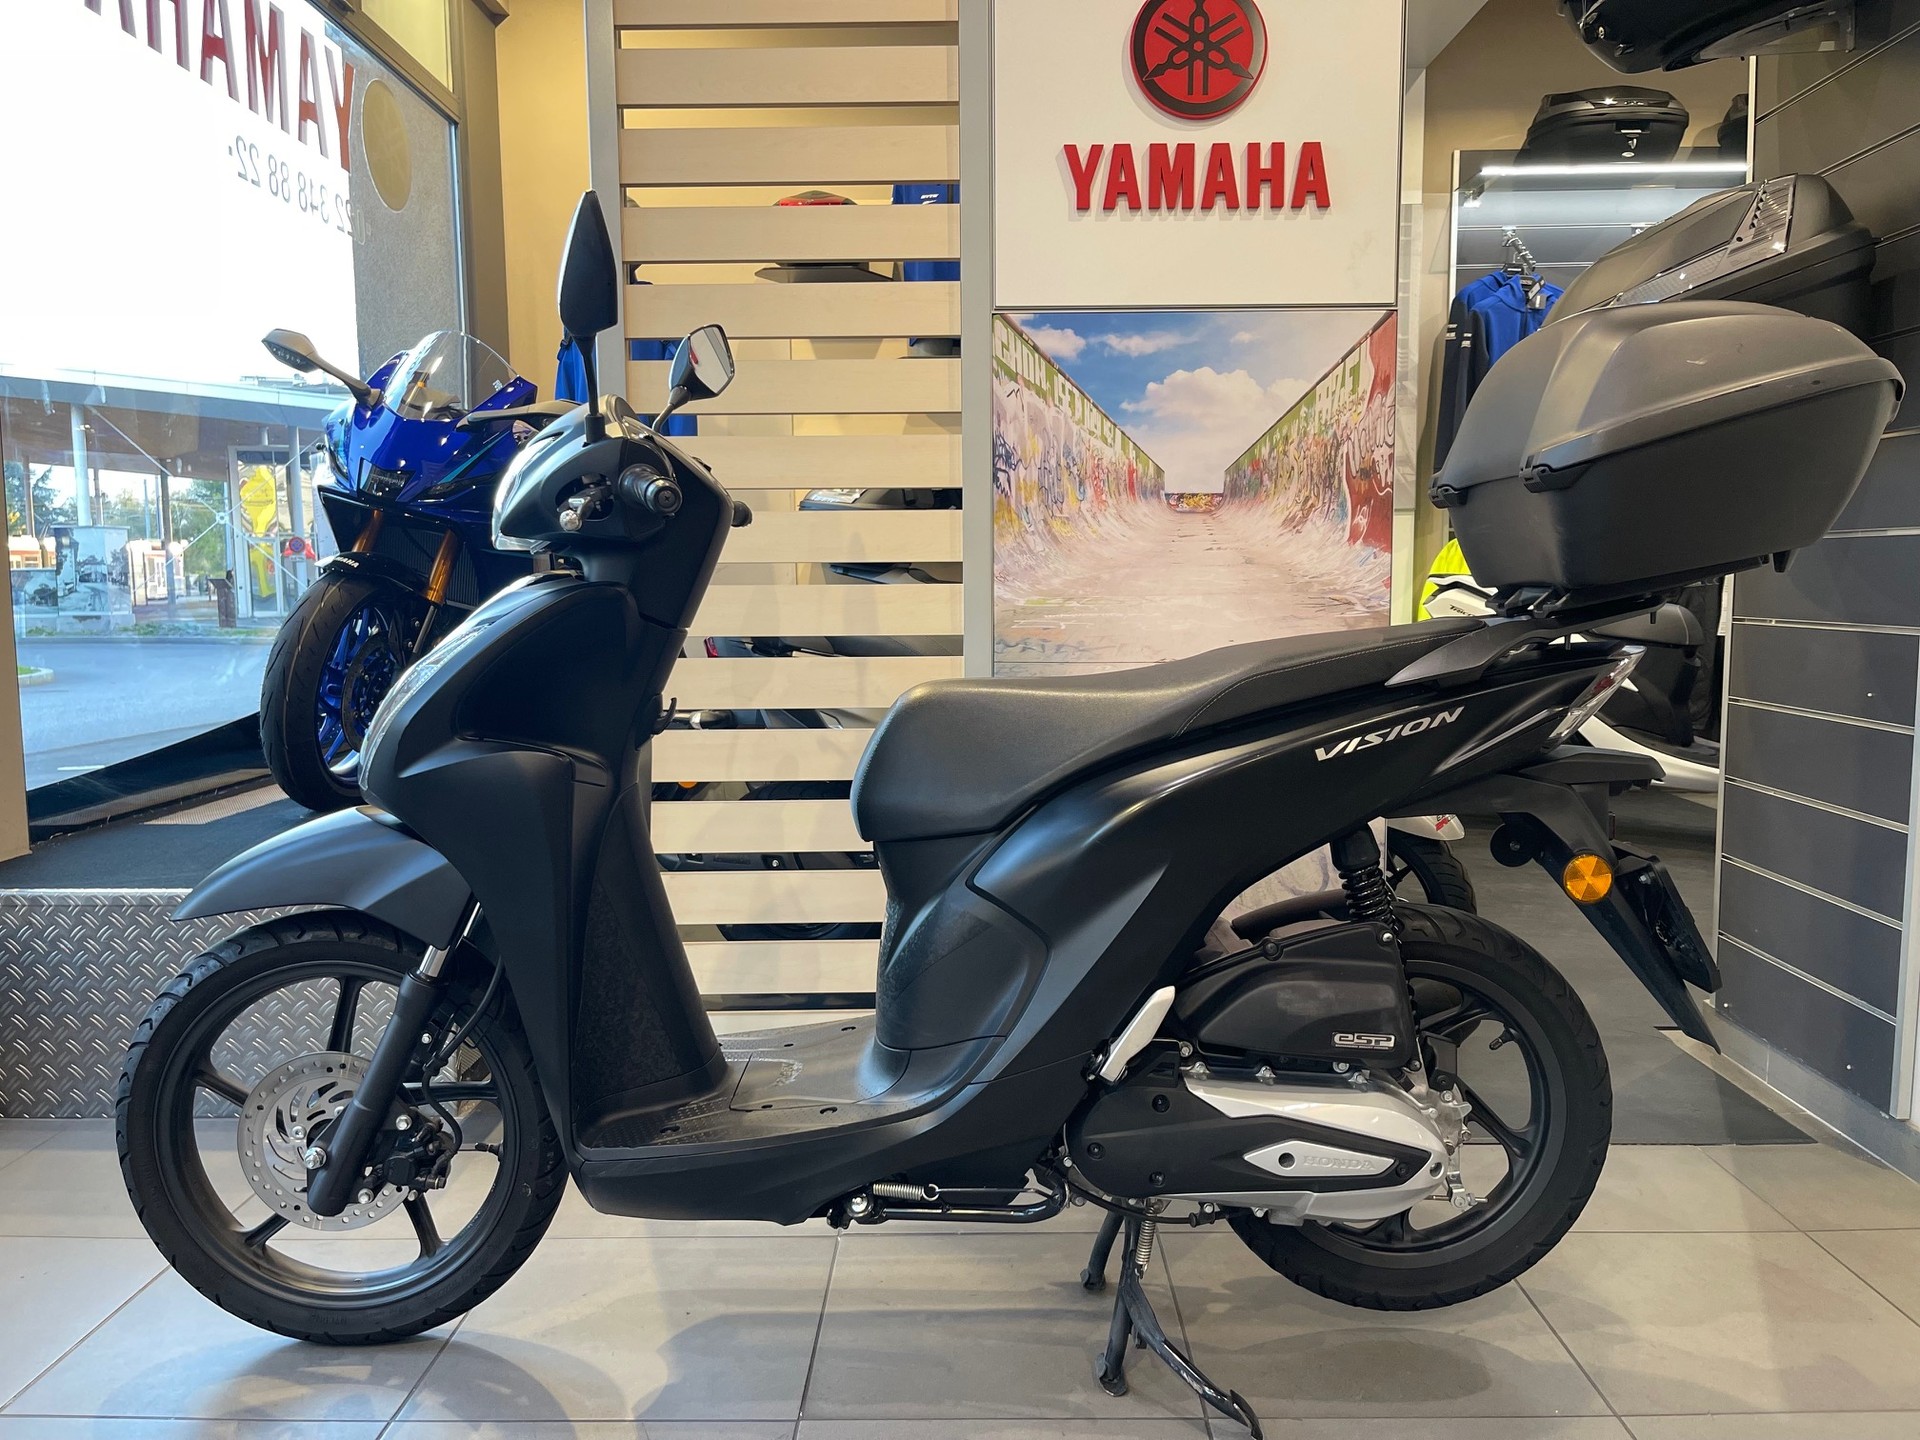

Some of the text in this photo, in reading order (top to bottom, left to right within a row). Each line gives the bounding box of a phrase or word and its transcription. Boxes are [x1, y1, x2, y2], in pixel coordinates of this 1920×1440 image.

[1063, 142, 1331, 211] YAMAHA
[1314, 706, 1465, 762] VISION
[1303, 1156, 1377, 1171] HONDA
